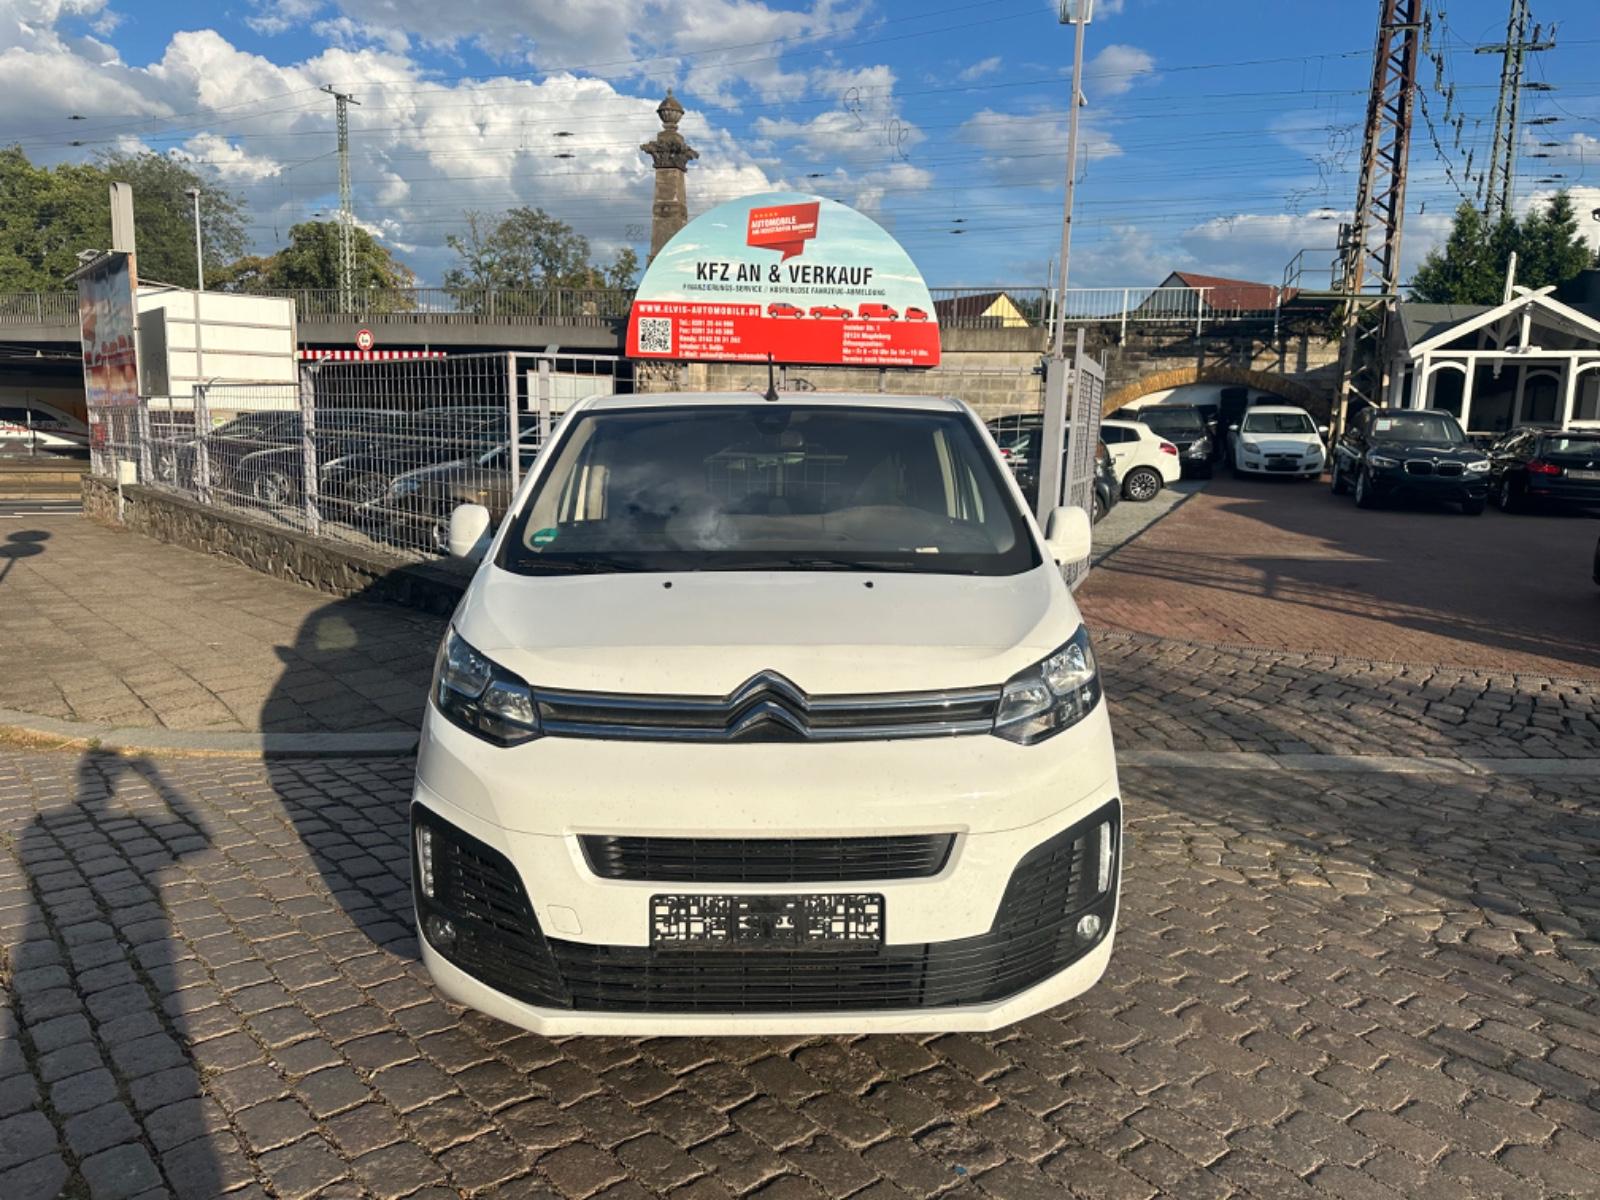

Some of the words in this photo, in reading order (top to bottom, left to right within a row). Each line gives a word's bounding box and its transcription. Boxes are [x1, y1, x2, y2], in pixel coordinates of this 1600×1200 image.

[751, 216, 797, 228] AUTOMOBILE
[696, 262, 730, 281] KFZ
[737, 264, 761, 282] AN
[768, 264, 781, 283] &
[789, 265, 874, 285] VERKAUF
[638, 304, 759, 316] WWW.ELVIS-AUTOMOBILE.DE
